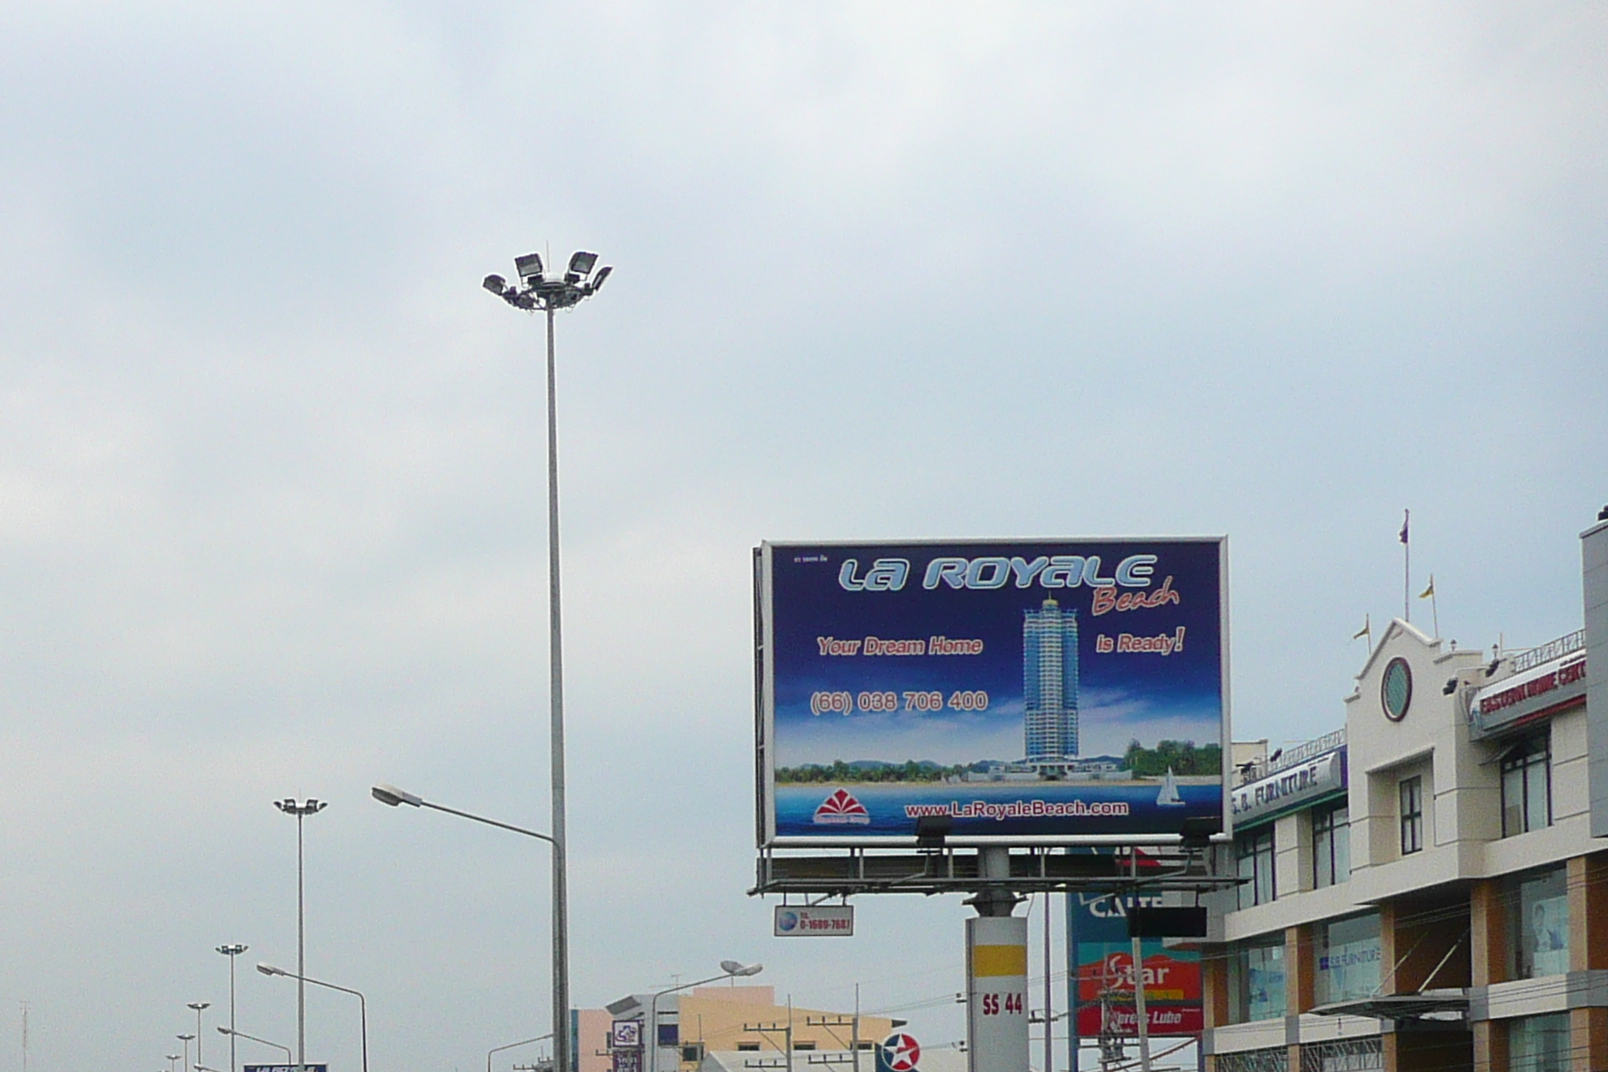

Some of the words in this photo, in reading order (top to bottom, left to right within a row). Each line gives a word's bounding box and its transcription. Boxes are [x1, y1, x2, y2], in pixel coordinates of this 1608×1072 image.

[1092, 576, 1180, 616] Beach
[818, 637, 860, 655] Your
[864, 637, 924, 655] Dream
[929, 636, 983, 655] Home
[1117, 626, 1185, 656] Ready!
[811, 691, 853, 716] (66)
[858, 691, 897, 712] 038
[903, 691, 942, 711] 706
[948, 691, 988, 711] 400
[1255, 766, 1318, 806] FURNITURE
[983, 993, 1000, 1015] SS
[1005, 992, 1023, 1015] 44
